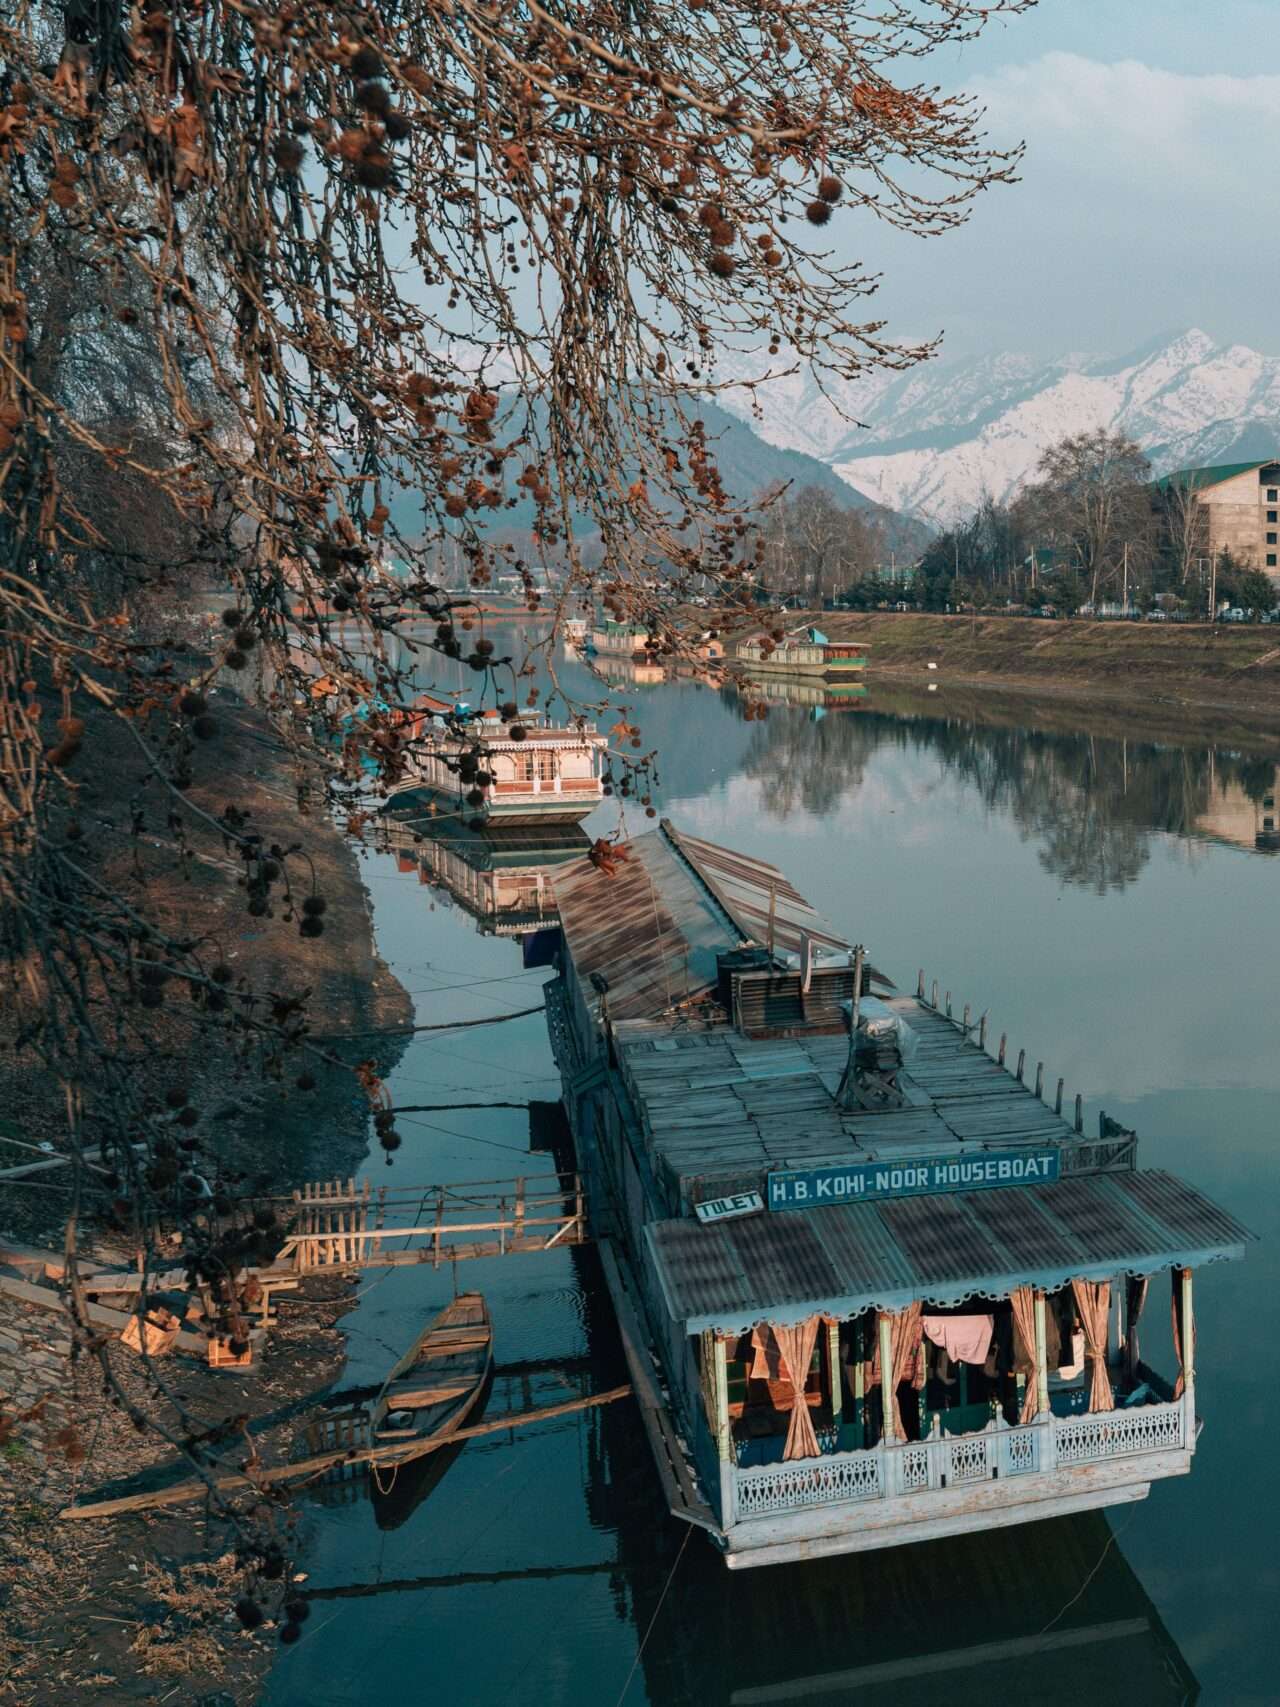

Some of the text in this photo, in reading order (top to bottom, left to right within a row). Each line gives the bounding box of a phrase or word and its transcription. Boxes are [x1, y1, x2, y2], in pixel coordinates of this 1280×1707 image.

[772, 1156, 1054, 1202] H.B. KOHI-NOOR HOUSEBOAT
